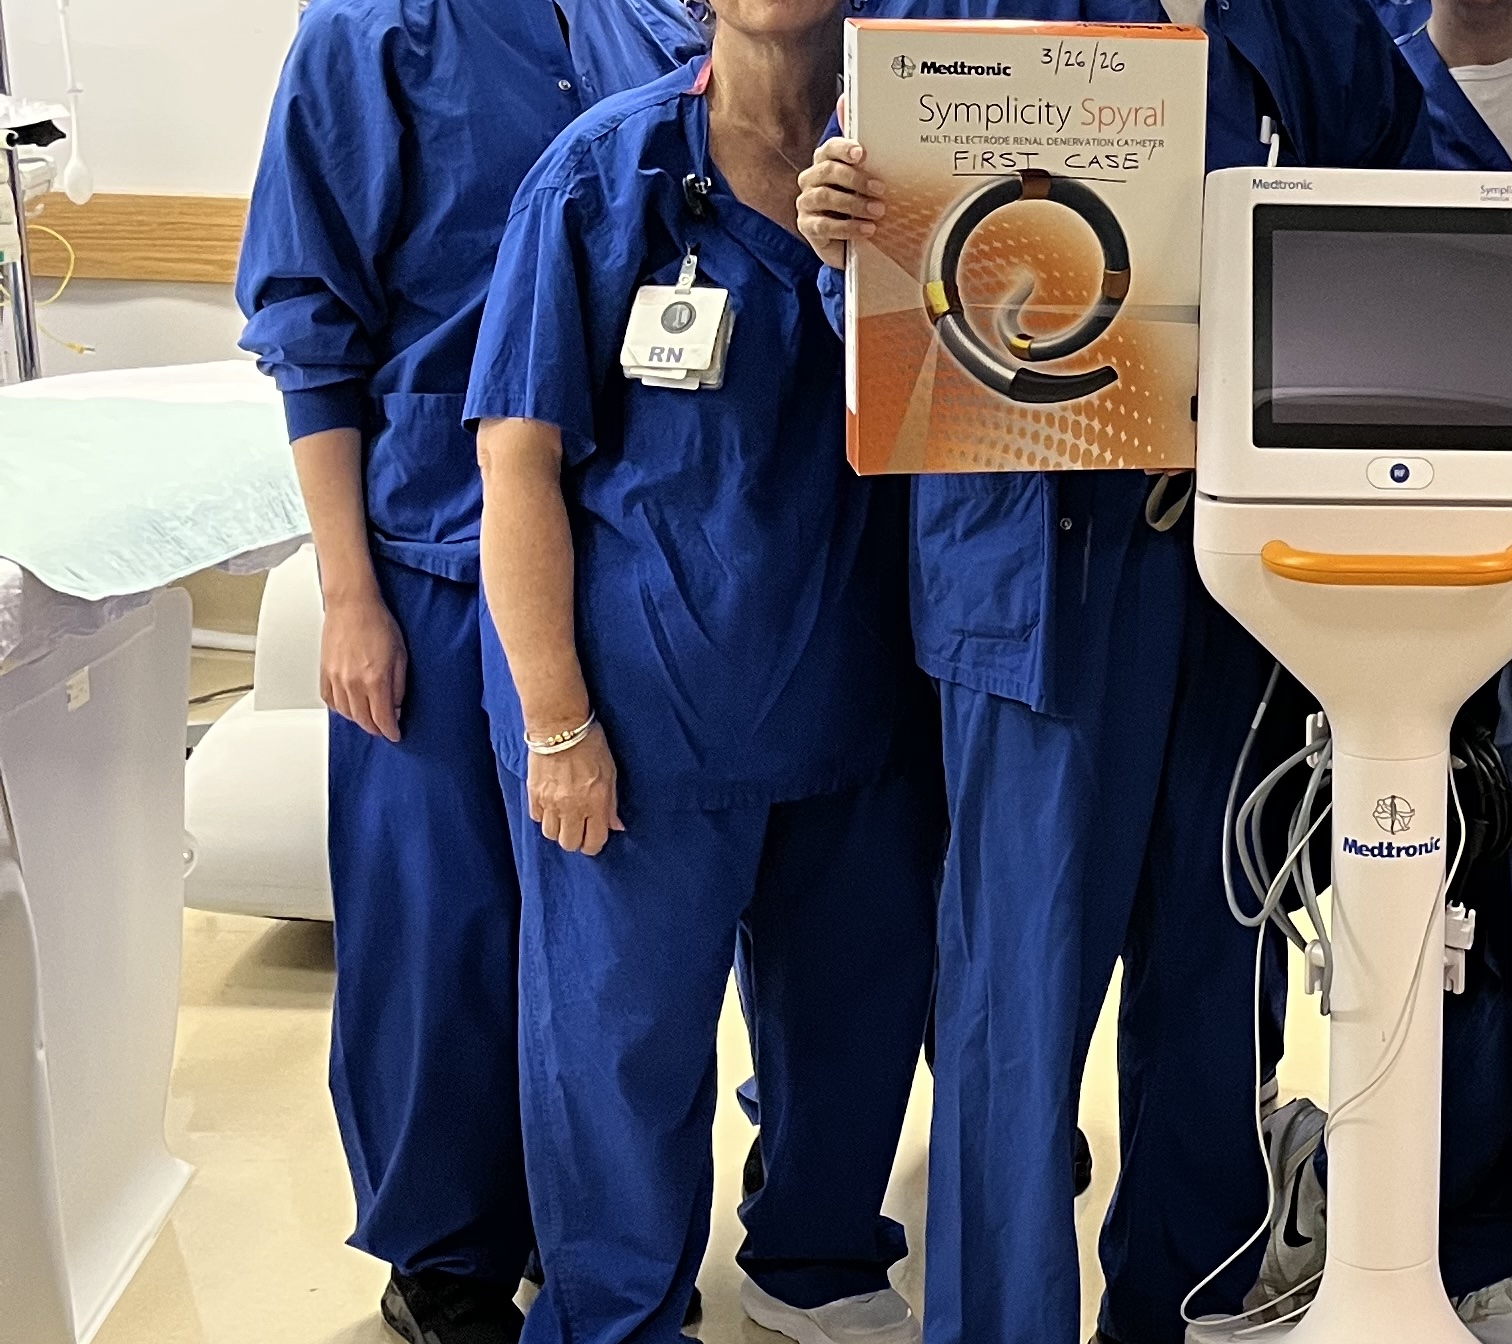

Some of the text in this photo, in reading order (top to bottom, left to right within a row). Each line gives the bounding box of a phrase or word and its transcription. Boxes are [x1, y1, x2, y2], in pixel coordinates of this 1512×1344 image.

[920, 61, 1012, 77] Medtronic
[1040, 40, 1125, 84] 3/26/26
[919, 94, 1165, 135] Symplicity Spyral
[1013, 136, 1044, 146] RENAL
[1046, 137, 1114, 148] DENERVATION
[1116, 138, 1165, 148] CATHETER
[954, 150, 1139, 171] FIRST CASE
[1251, 178, 1313, 191] Medtronic
[648, 346, 684, 363] RN
[1342, 836, 1441, 858] Medtronic
